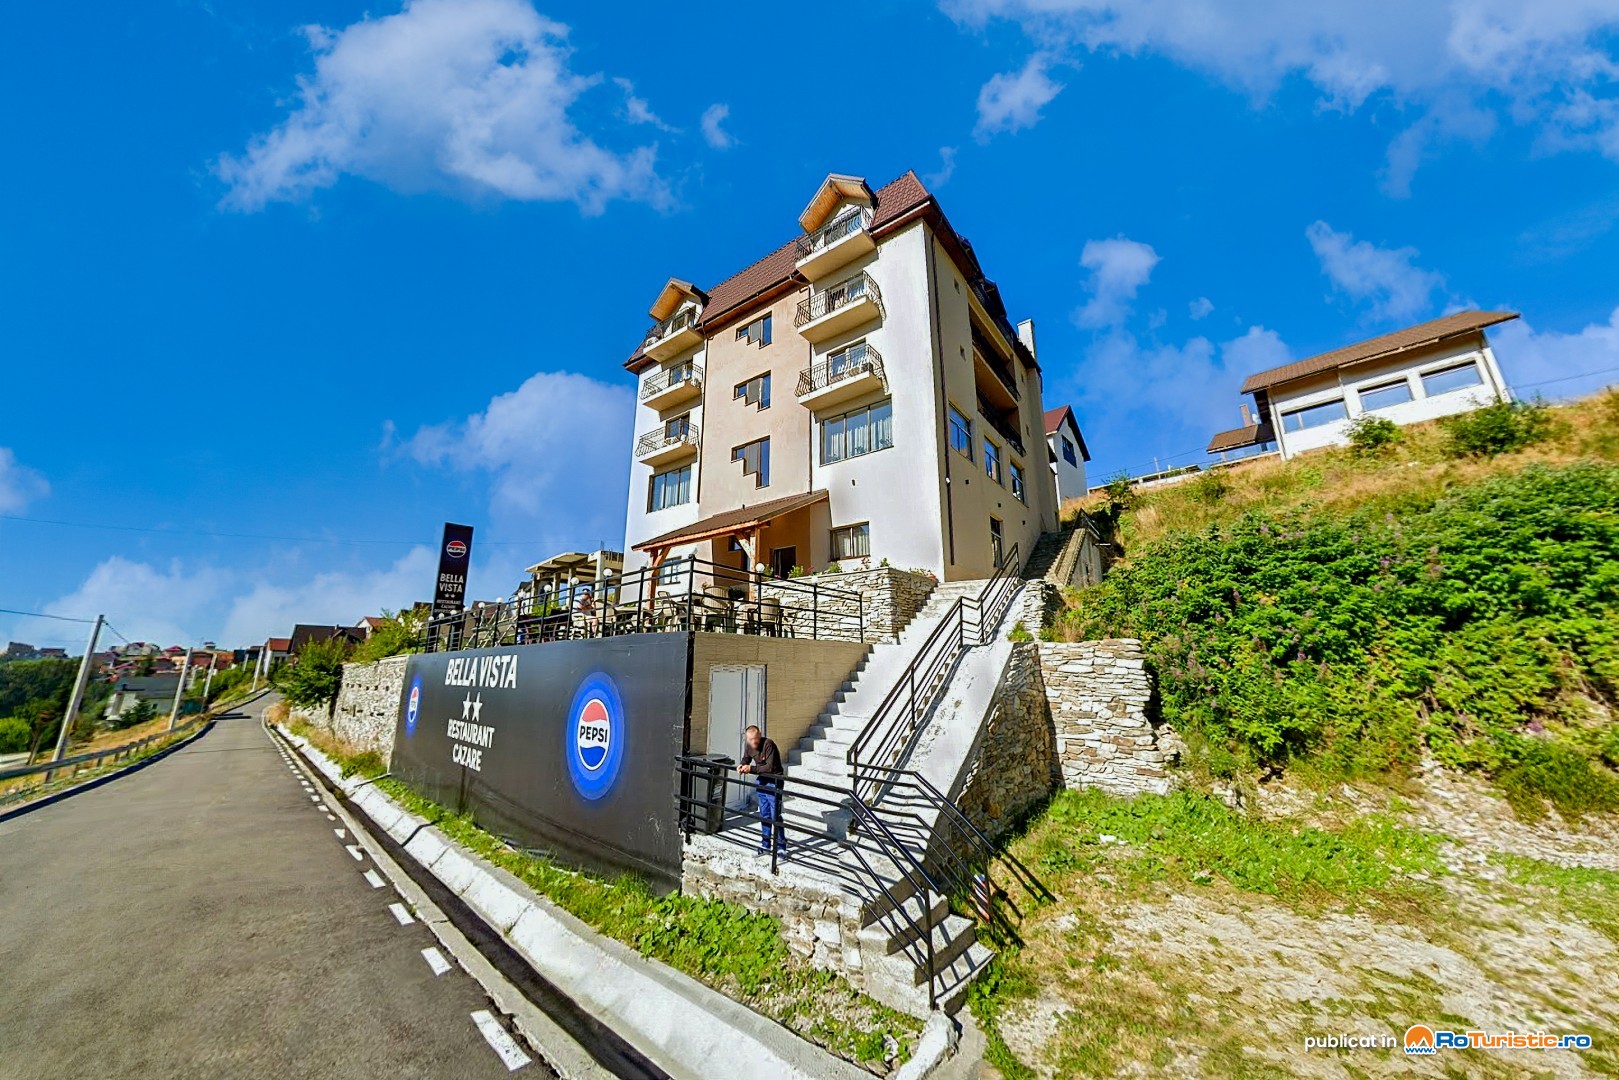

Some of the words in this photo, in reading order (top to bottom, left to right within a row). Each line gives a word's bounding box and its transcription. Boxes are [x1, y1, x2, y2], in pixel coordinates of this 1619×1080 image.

[439, 583, 463, 593] VISTA
[440, 573, 464, 583] BELLA
[445, 658, 477, 687] BELLA
[479, 654, 518, 689] VISTA
[447, 719, 494, 748] RESTAURANT
[579, 725, 608, 743] PEPSI
[452, 743, 482, 772] CAZARE
